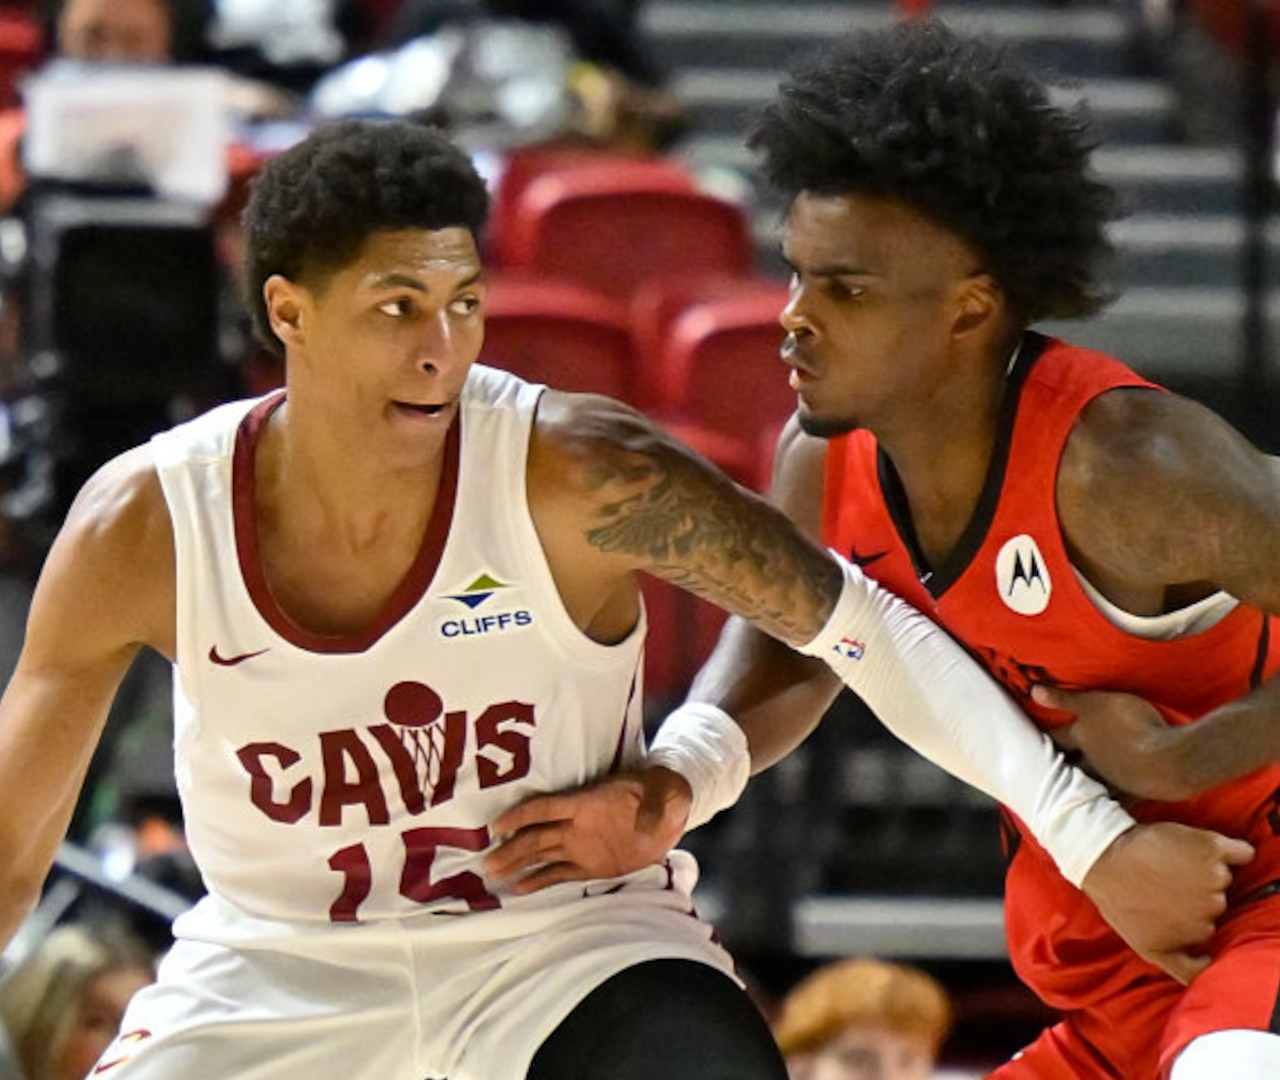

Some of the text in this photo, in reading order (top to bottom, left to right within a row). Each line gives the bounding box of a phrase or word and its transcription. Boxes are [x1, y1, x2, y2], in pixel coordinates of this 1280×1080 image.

[441, 610, 533, 638] CLIFFS
[236, 699, 536, 827] CAVS
[327, 825, 502, 923] 15
